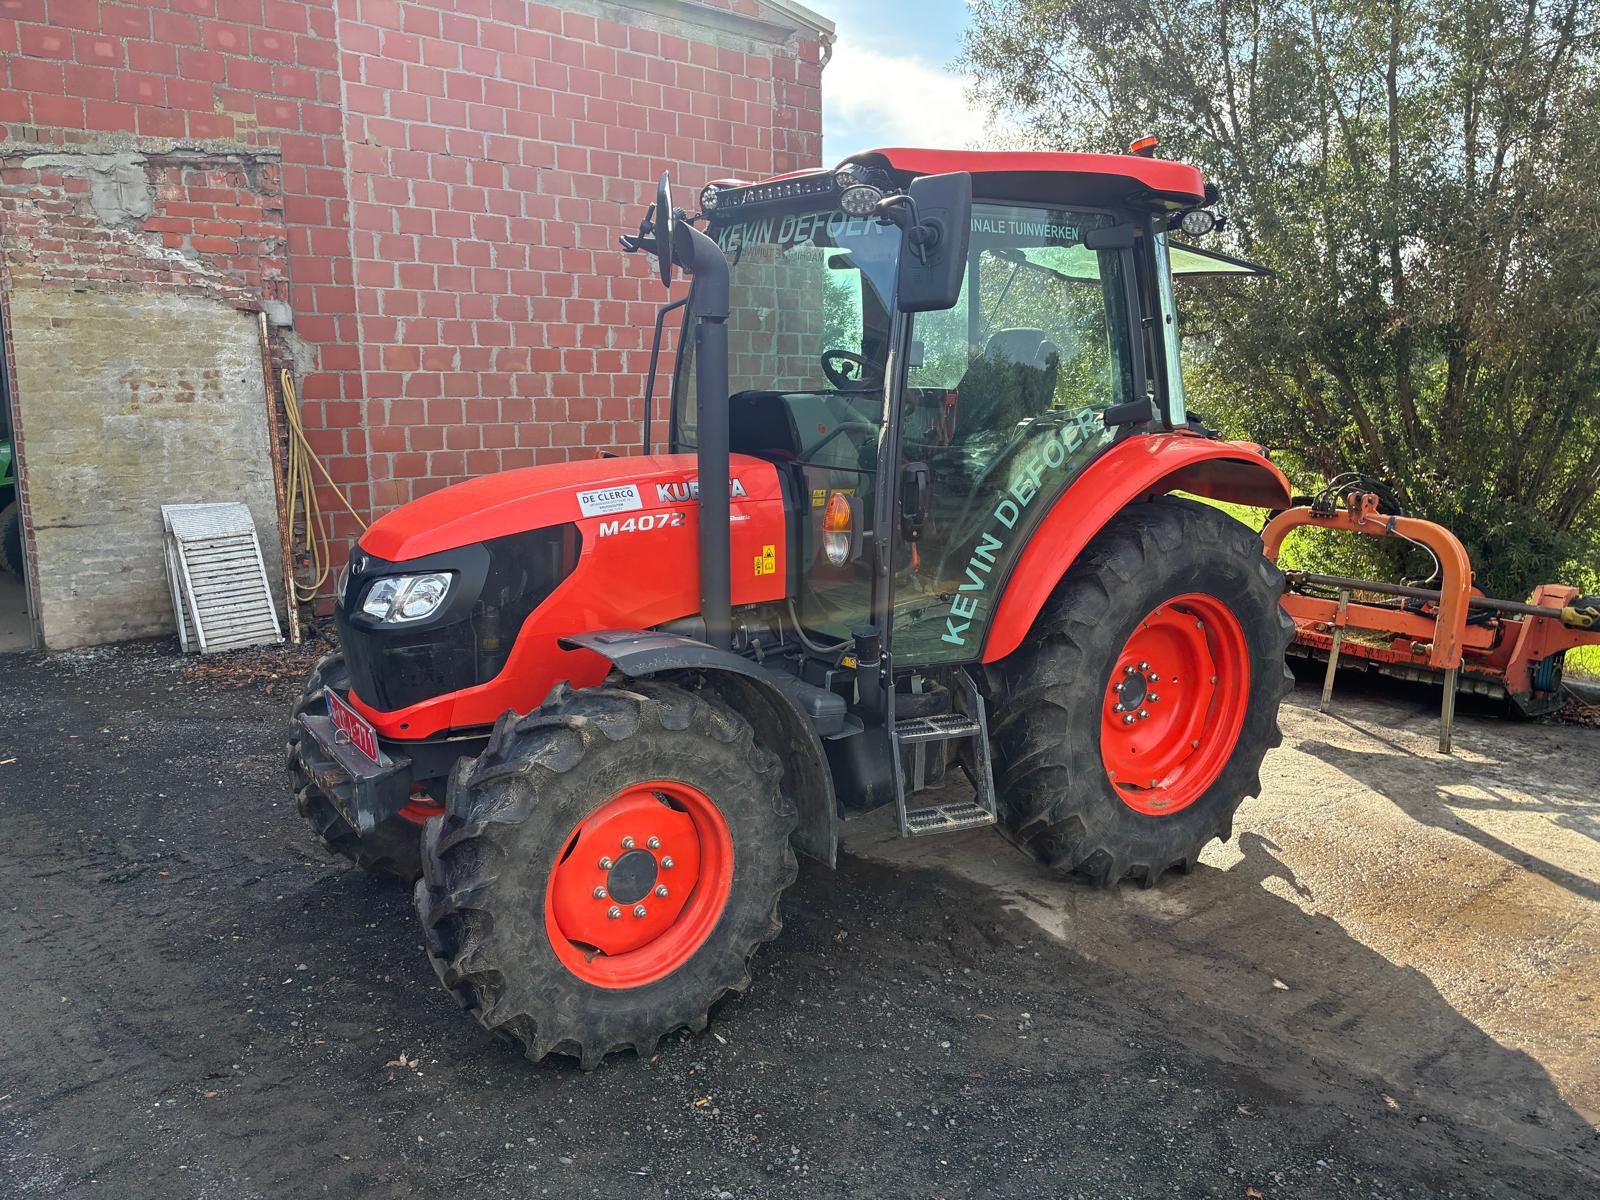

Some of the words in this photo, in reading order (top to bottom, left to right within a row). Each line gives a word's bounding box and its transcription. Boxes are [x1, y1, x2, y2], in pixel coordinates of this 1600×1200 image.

[717, 217, 775, 253] KEVIN
[1008, 221, 1079, 241] TUINWERKEN
[582, 495, 596, 504] DE
[597, 489, 634, 501] CLERCQ
[599, 511, 685, 538] M4072
[941, 532, 1003, 645] KEVIN
[993, 407, 1098, 530] DEFOER
